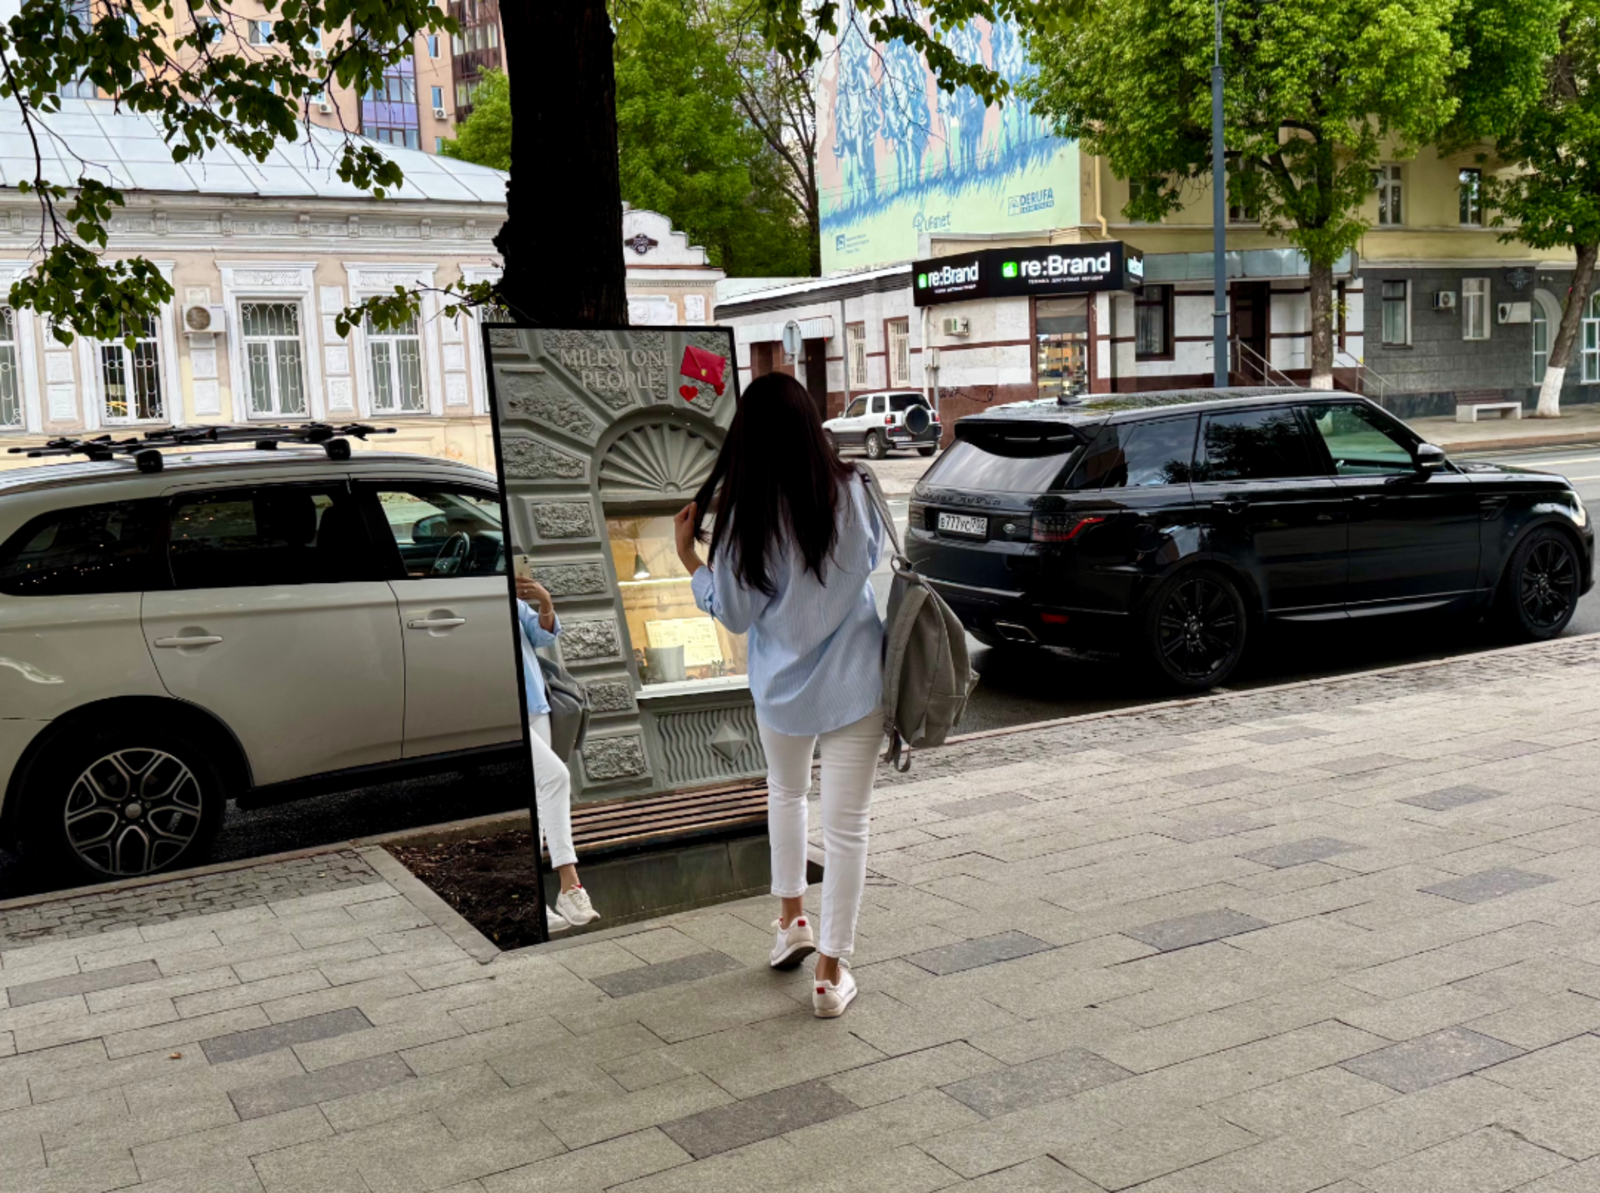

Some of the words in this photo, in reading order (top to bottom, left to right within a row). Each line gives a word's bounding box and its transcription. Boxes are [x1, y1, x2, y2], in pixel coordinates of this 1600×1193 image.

[1019, 187, 1054, 206] DERUFA
[928, 260, 979, 287] re:Brand
[1020, 252, 1111, 277] re:Brand
[559, 348, 674, 367] MILESTONE
[581, 371, 660, 389] PEOPLE
